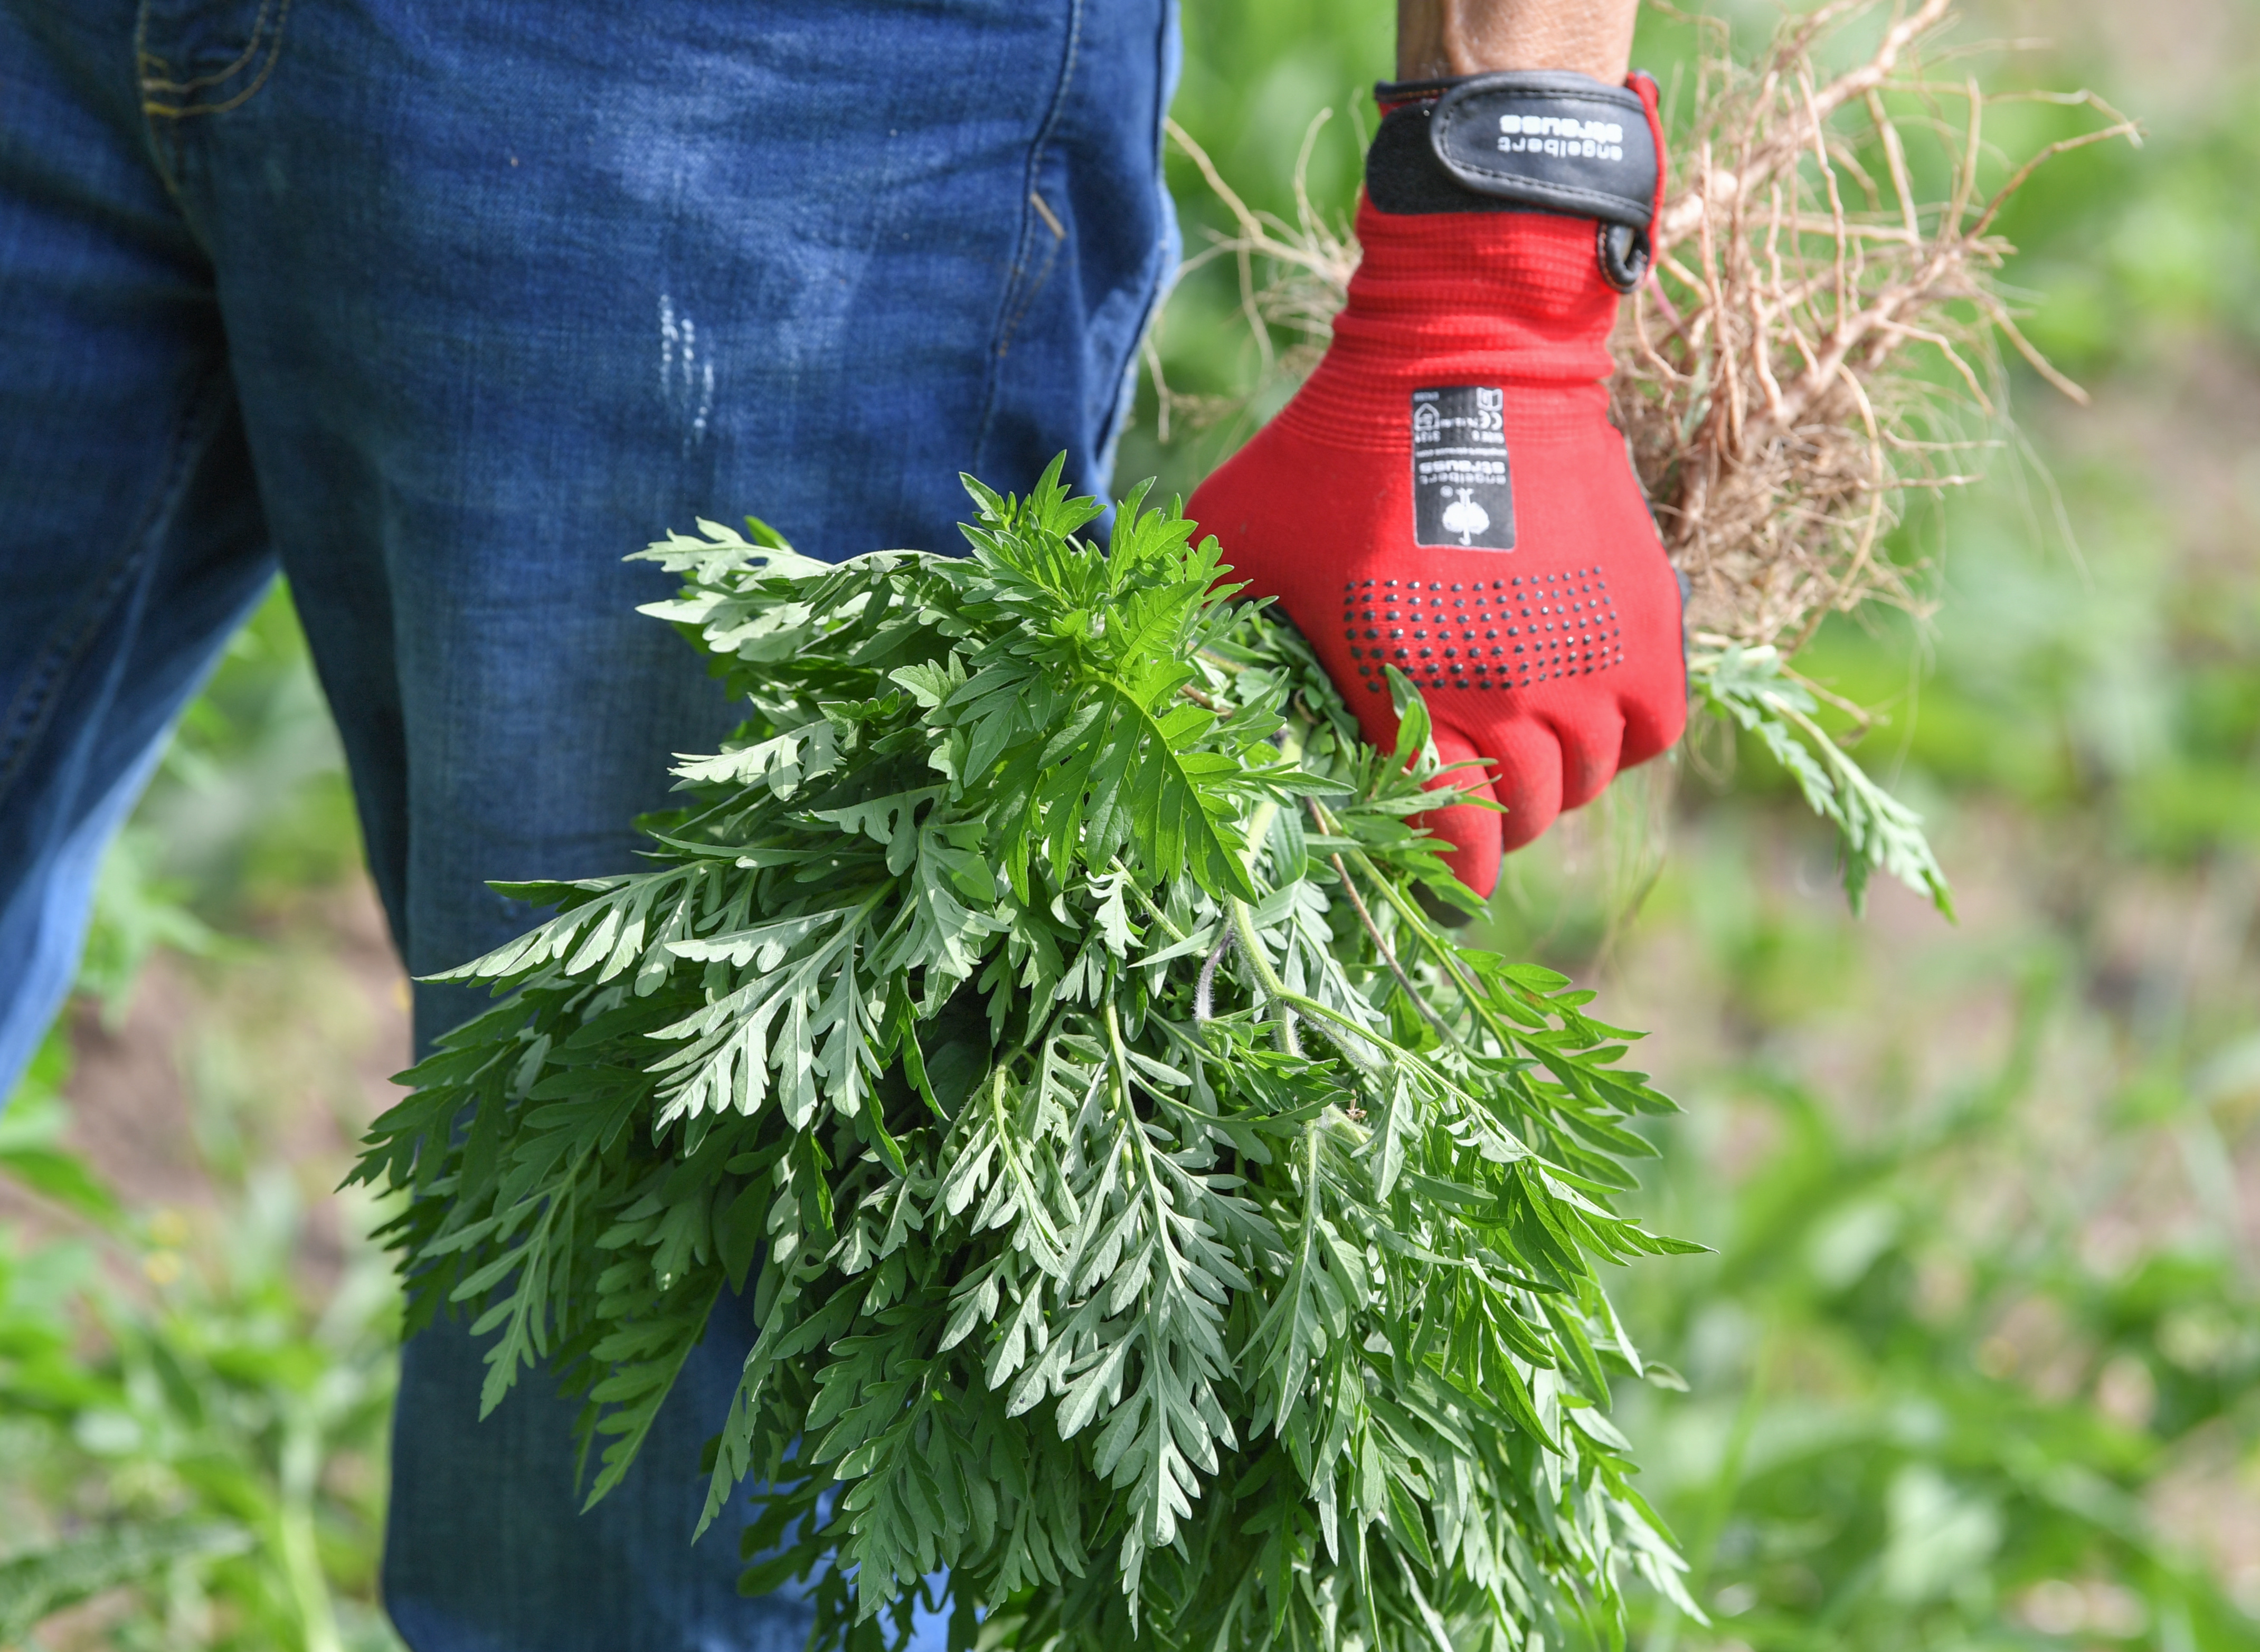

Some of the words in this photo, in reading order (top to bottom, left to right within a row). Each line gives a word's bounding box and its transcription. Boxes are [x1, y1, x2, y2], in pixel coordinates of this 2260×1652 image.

[1499, 115, 1623, 143] strauss
[1497, 137, 1623, 160] engelbert
[1419, 460, 1506, 474] strauss
[1419, 472, 1506, 485] engelbert
